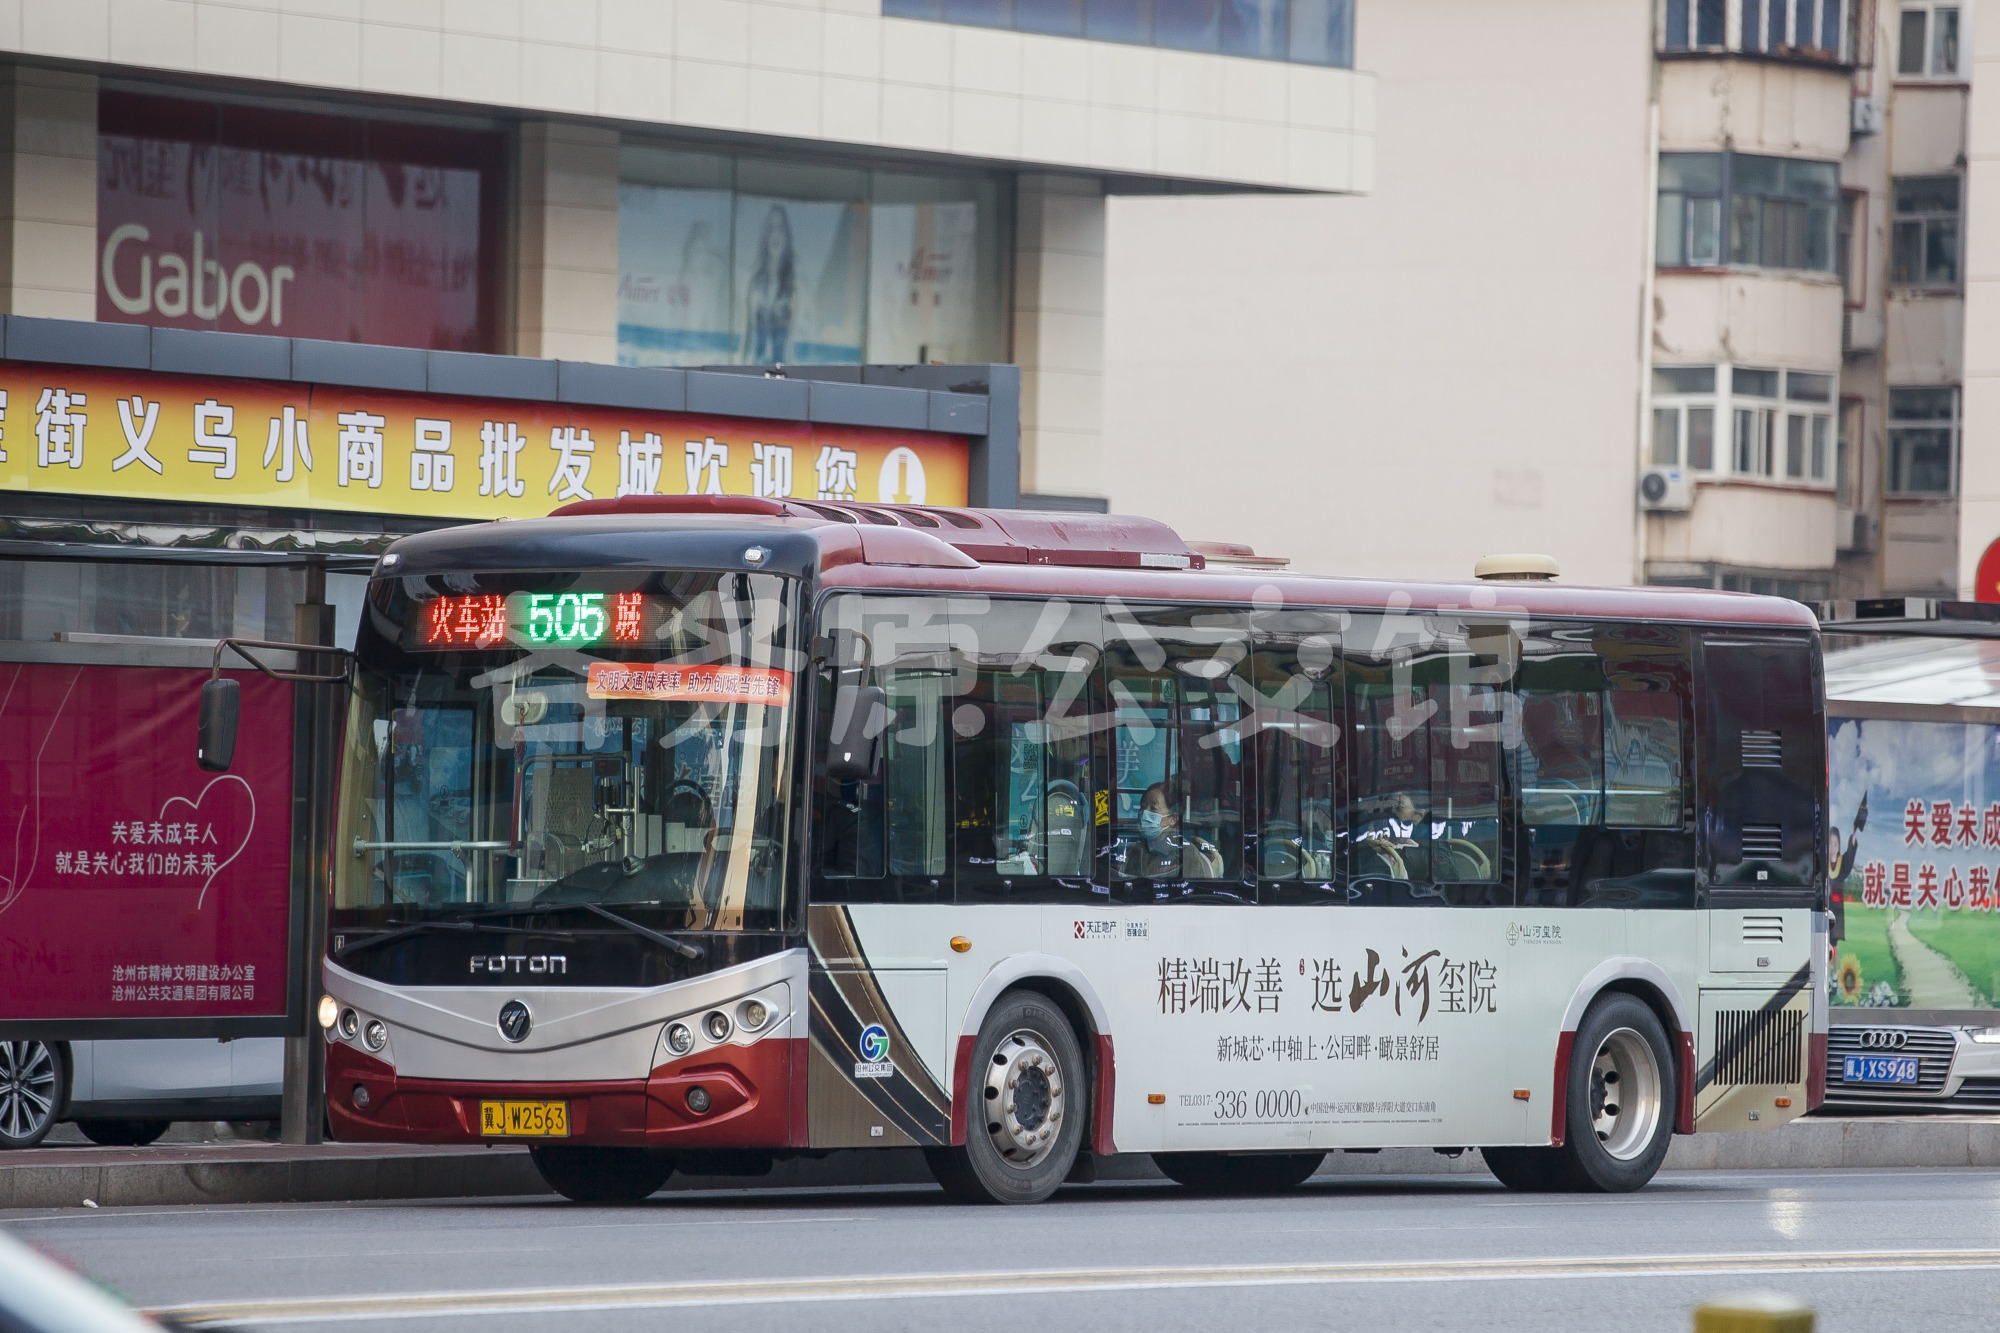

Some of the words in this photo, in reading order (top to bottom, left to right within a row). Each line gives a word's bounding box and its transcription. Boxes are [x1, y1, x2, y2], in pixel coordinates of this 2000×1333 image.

[103, 224, 295, 327] Gabor
[0, 387, 858, 501] 街义乌小商品批发城欢迎您
[428, 595, 507, 643] 火车站
[529, 593, 605, 641] 505
[595, 670, 682, 691] 文明交通做表率
[687, 674, 781, 697] 助力创城当先锋
[112, 821, 218, 845] 关爱未成年人
[55, 851, 218, 876] 就是关心我们的未来
[1086, 921, 1117, 934] 天正地产
[1522, 925, 1562, 939] 山河玺院
[112, 964, 256, 982] 沧州市精神文明建设办公室
[470, 955, 567, 974] FOTON
[112, 984, 255, 1001] 沧州公共交通集团有限公司
[1157, 957, 1284, 1015] 精端改善
[1311, 945, 1498, 1027] 选山河玺院
[1255, 1089, 1301, 1118] 0000
